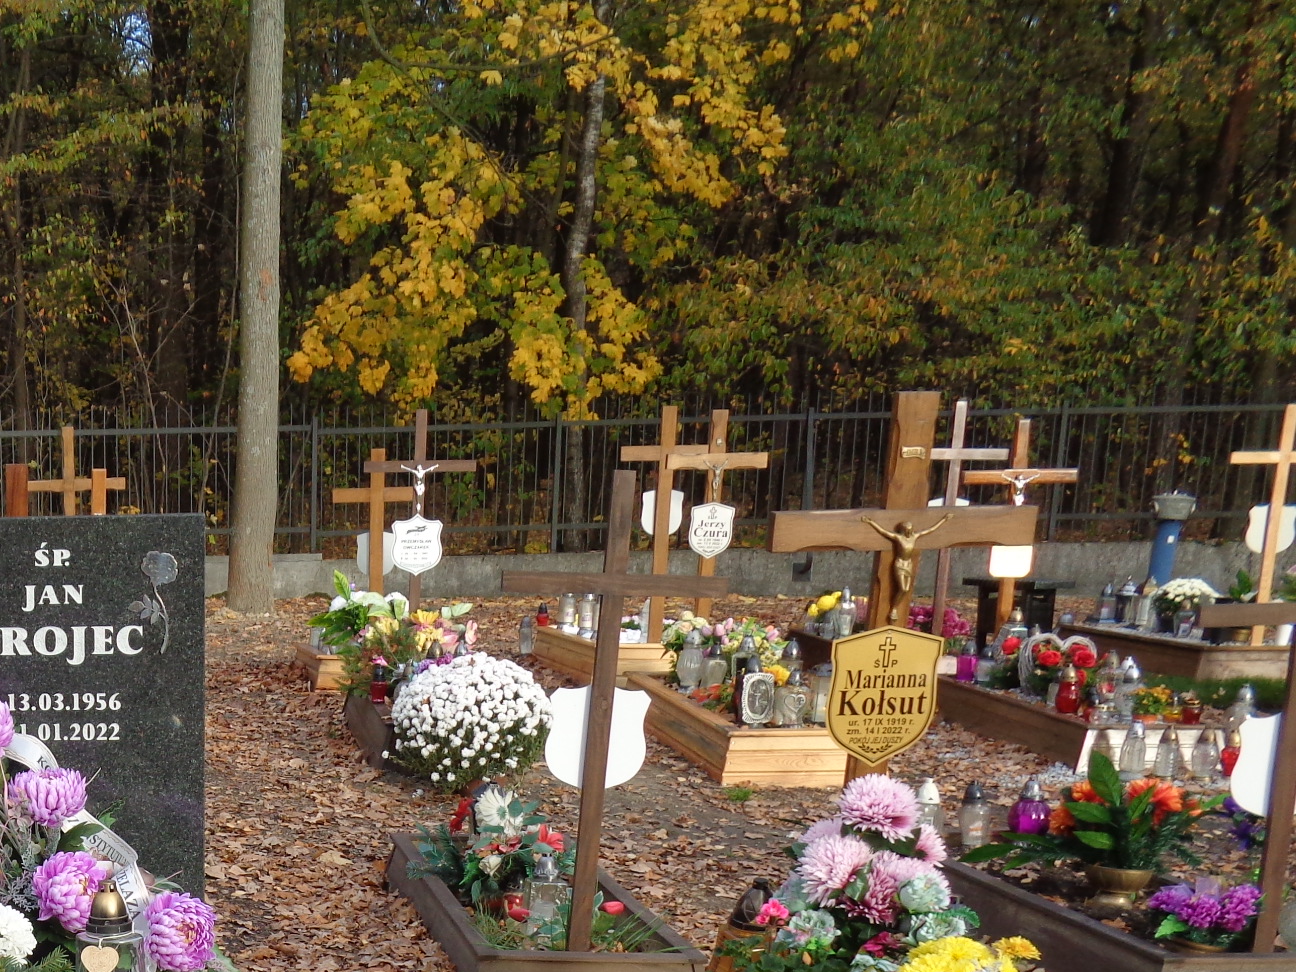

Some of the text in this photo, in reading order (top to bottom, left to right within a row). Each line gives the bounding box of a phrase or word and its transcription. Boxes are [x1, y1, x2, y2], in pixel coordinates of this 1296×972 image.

[694, 527, 728, 537] Czura
[698, 520, 725, 529] Jerzy
[34, 542, 71, 567] ŚP.
[21, 584, 84, 612] JAN
[844, 669, 927, 689] Marianna
[7, 692, 122, 711] 13.03.1956
[836, 689, 927, 716] Kołsut
[863, 718, 873, 726] 17
[874, 718, 884, 726] IX
[886, 718, 907, 726] 1919
[865, 727, 875, 735] 14
